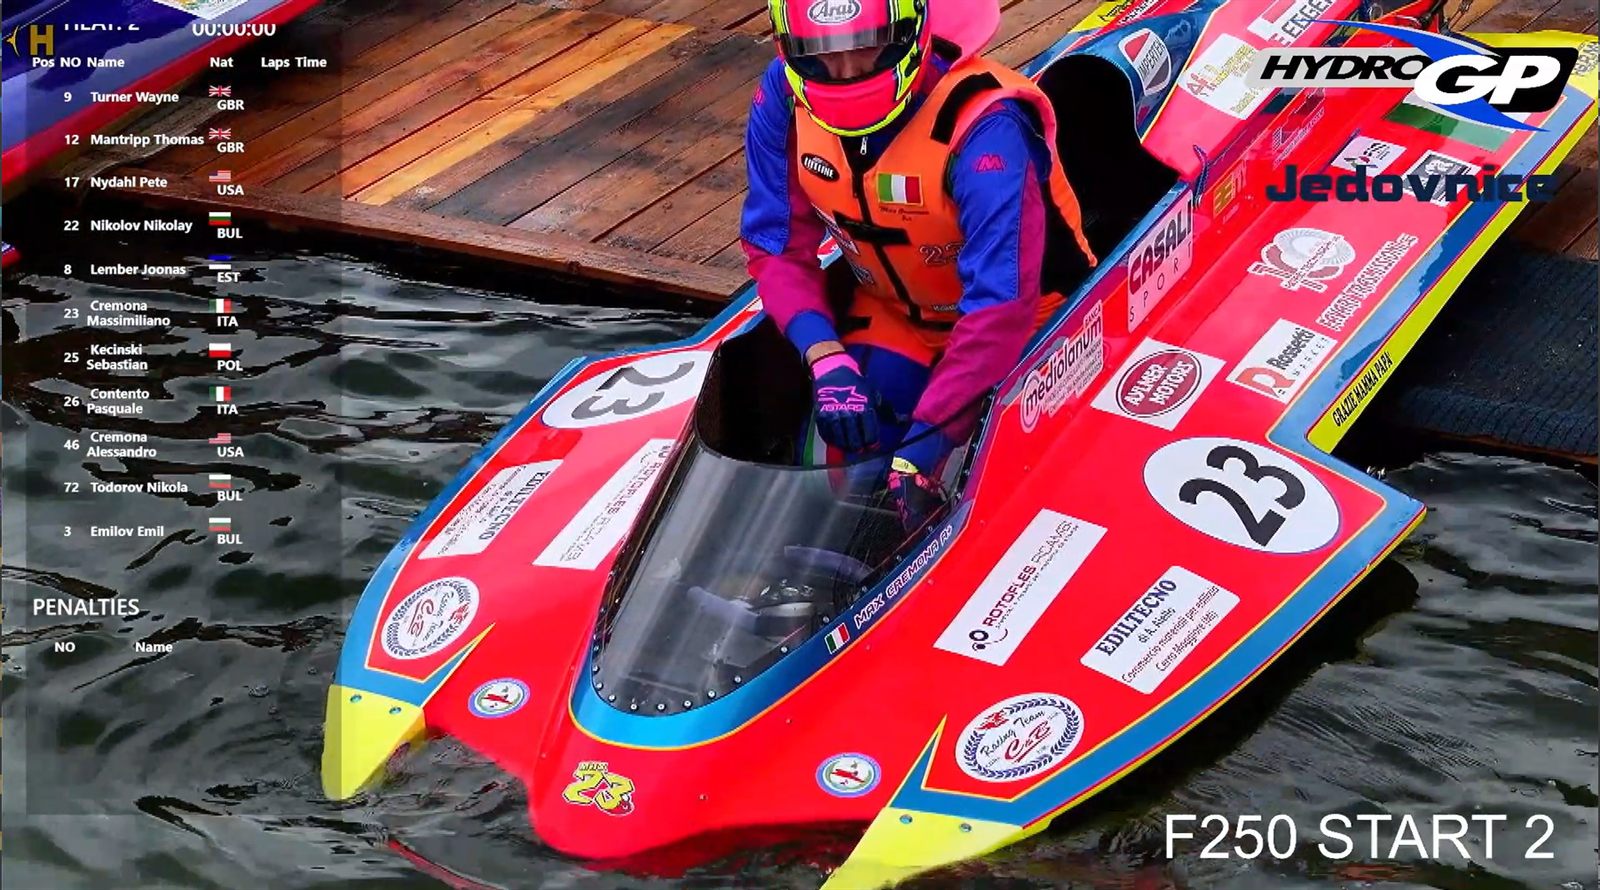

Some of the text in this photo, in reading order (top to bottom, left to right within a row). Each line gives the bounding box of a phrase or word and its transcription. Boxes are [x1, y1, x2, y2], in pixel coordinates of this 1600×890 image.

[1129, 199, 1192, 295] CASALI
[1129, 241, 1192, 323] SPORT
[571, 360, 695, 420] 23
[1025, 316, 1101, 417] mediolanum
[1149, 361, 1195, 406] MOTORS
[820, 403, 865, 412] ASTARS
[1331, 391, 1358, 427] GRAZIE
[1355, 370, 1379, 402] MAMMA
[1178, 444, 1307, 548] 23
[853, 593, 885, 630] MAX
[885, 539, 940, 599] CREMONA
[982, 565, 1037, 627] ROTOFLES
[1095, 578, 1178, 657] EDILTECNO
[1121, 645, 1161, 683] Commercio
[980, 728, 1017, 757] Racing
[1013, 710, 1046, 728] Team
[562, 770, 635, 811] 23
